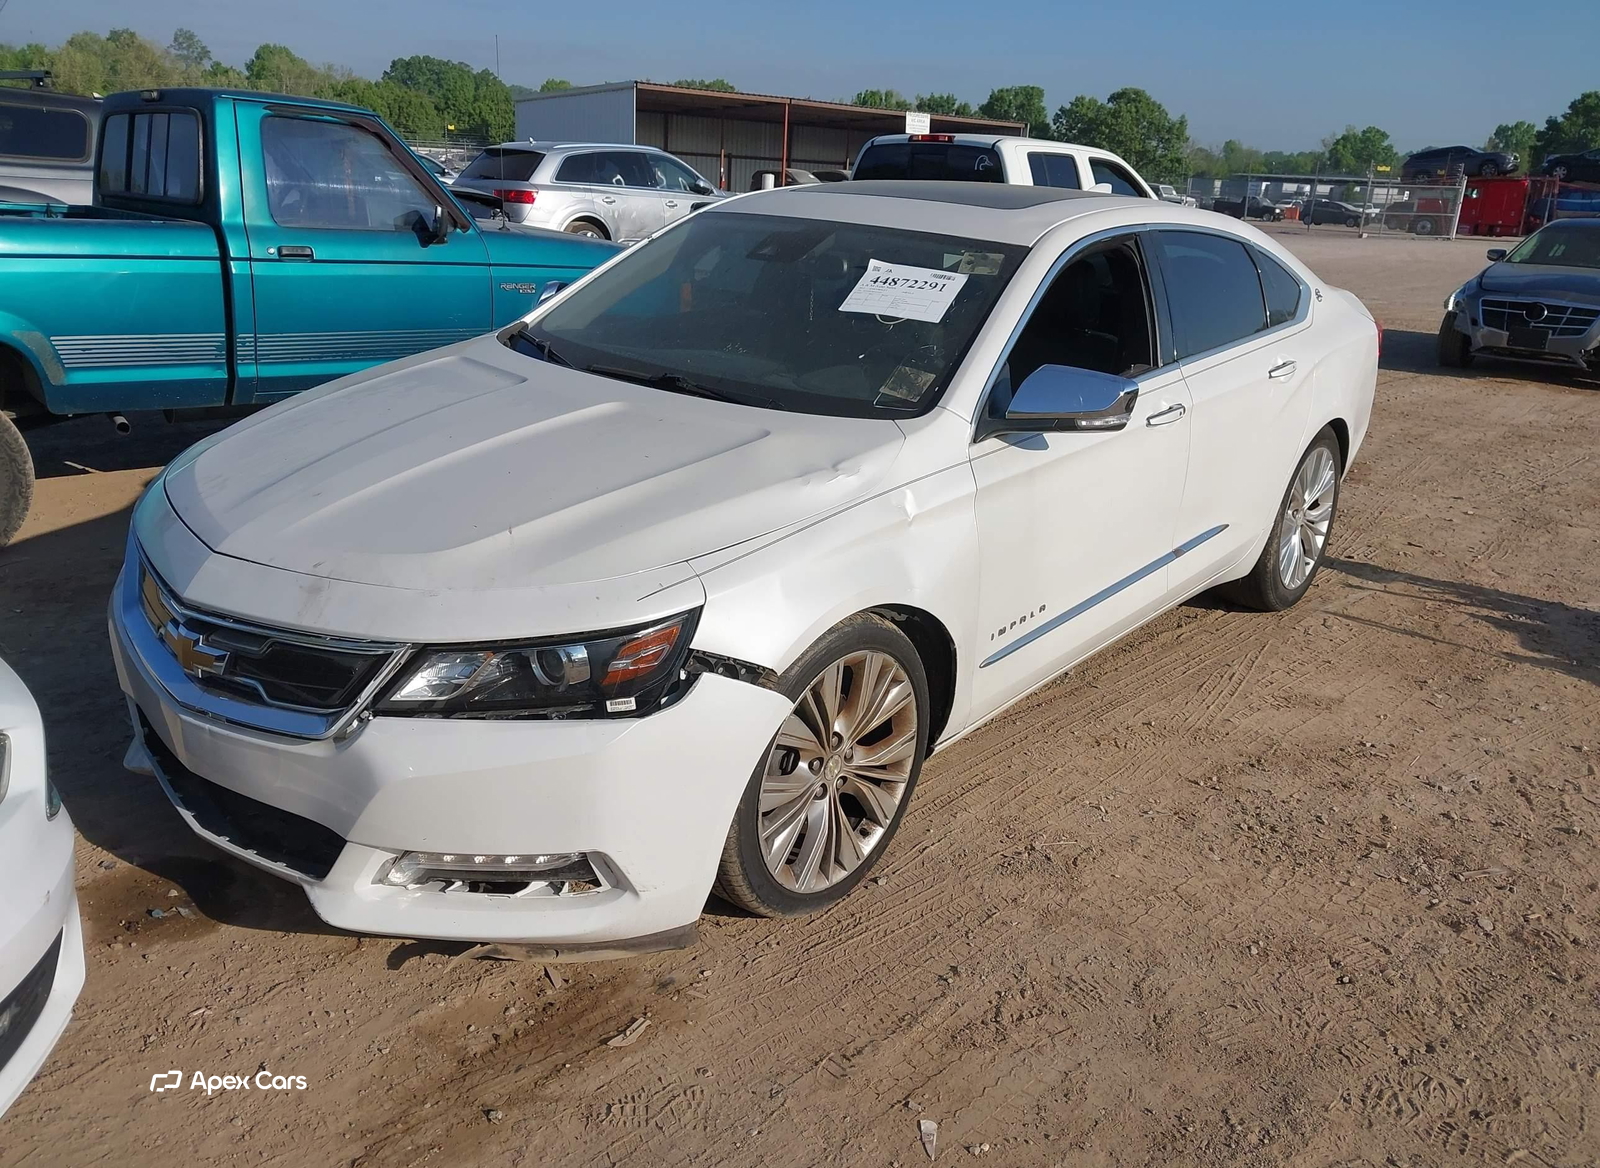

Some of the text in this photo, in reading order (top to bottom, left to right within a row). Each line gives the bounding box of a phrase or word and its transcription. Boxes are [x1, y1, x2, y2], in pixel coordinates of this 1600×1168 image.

[500, 282, 536, 291] RANGER
[870, 275, 947, 293] 44872291
[990, 604, 1046, 641] IMPALA
